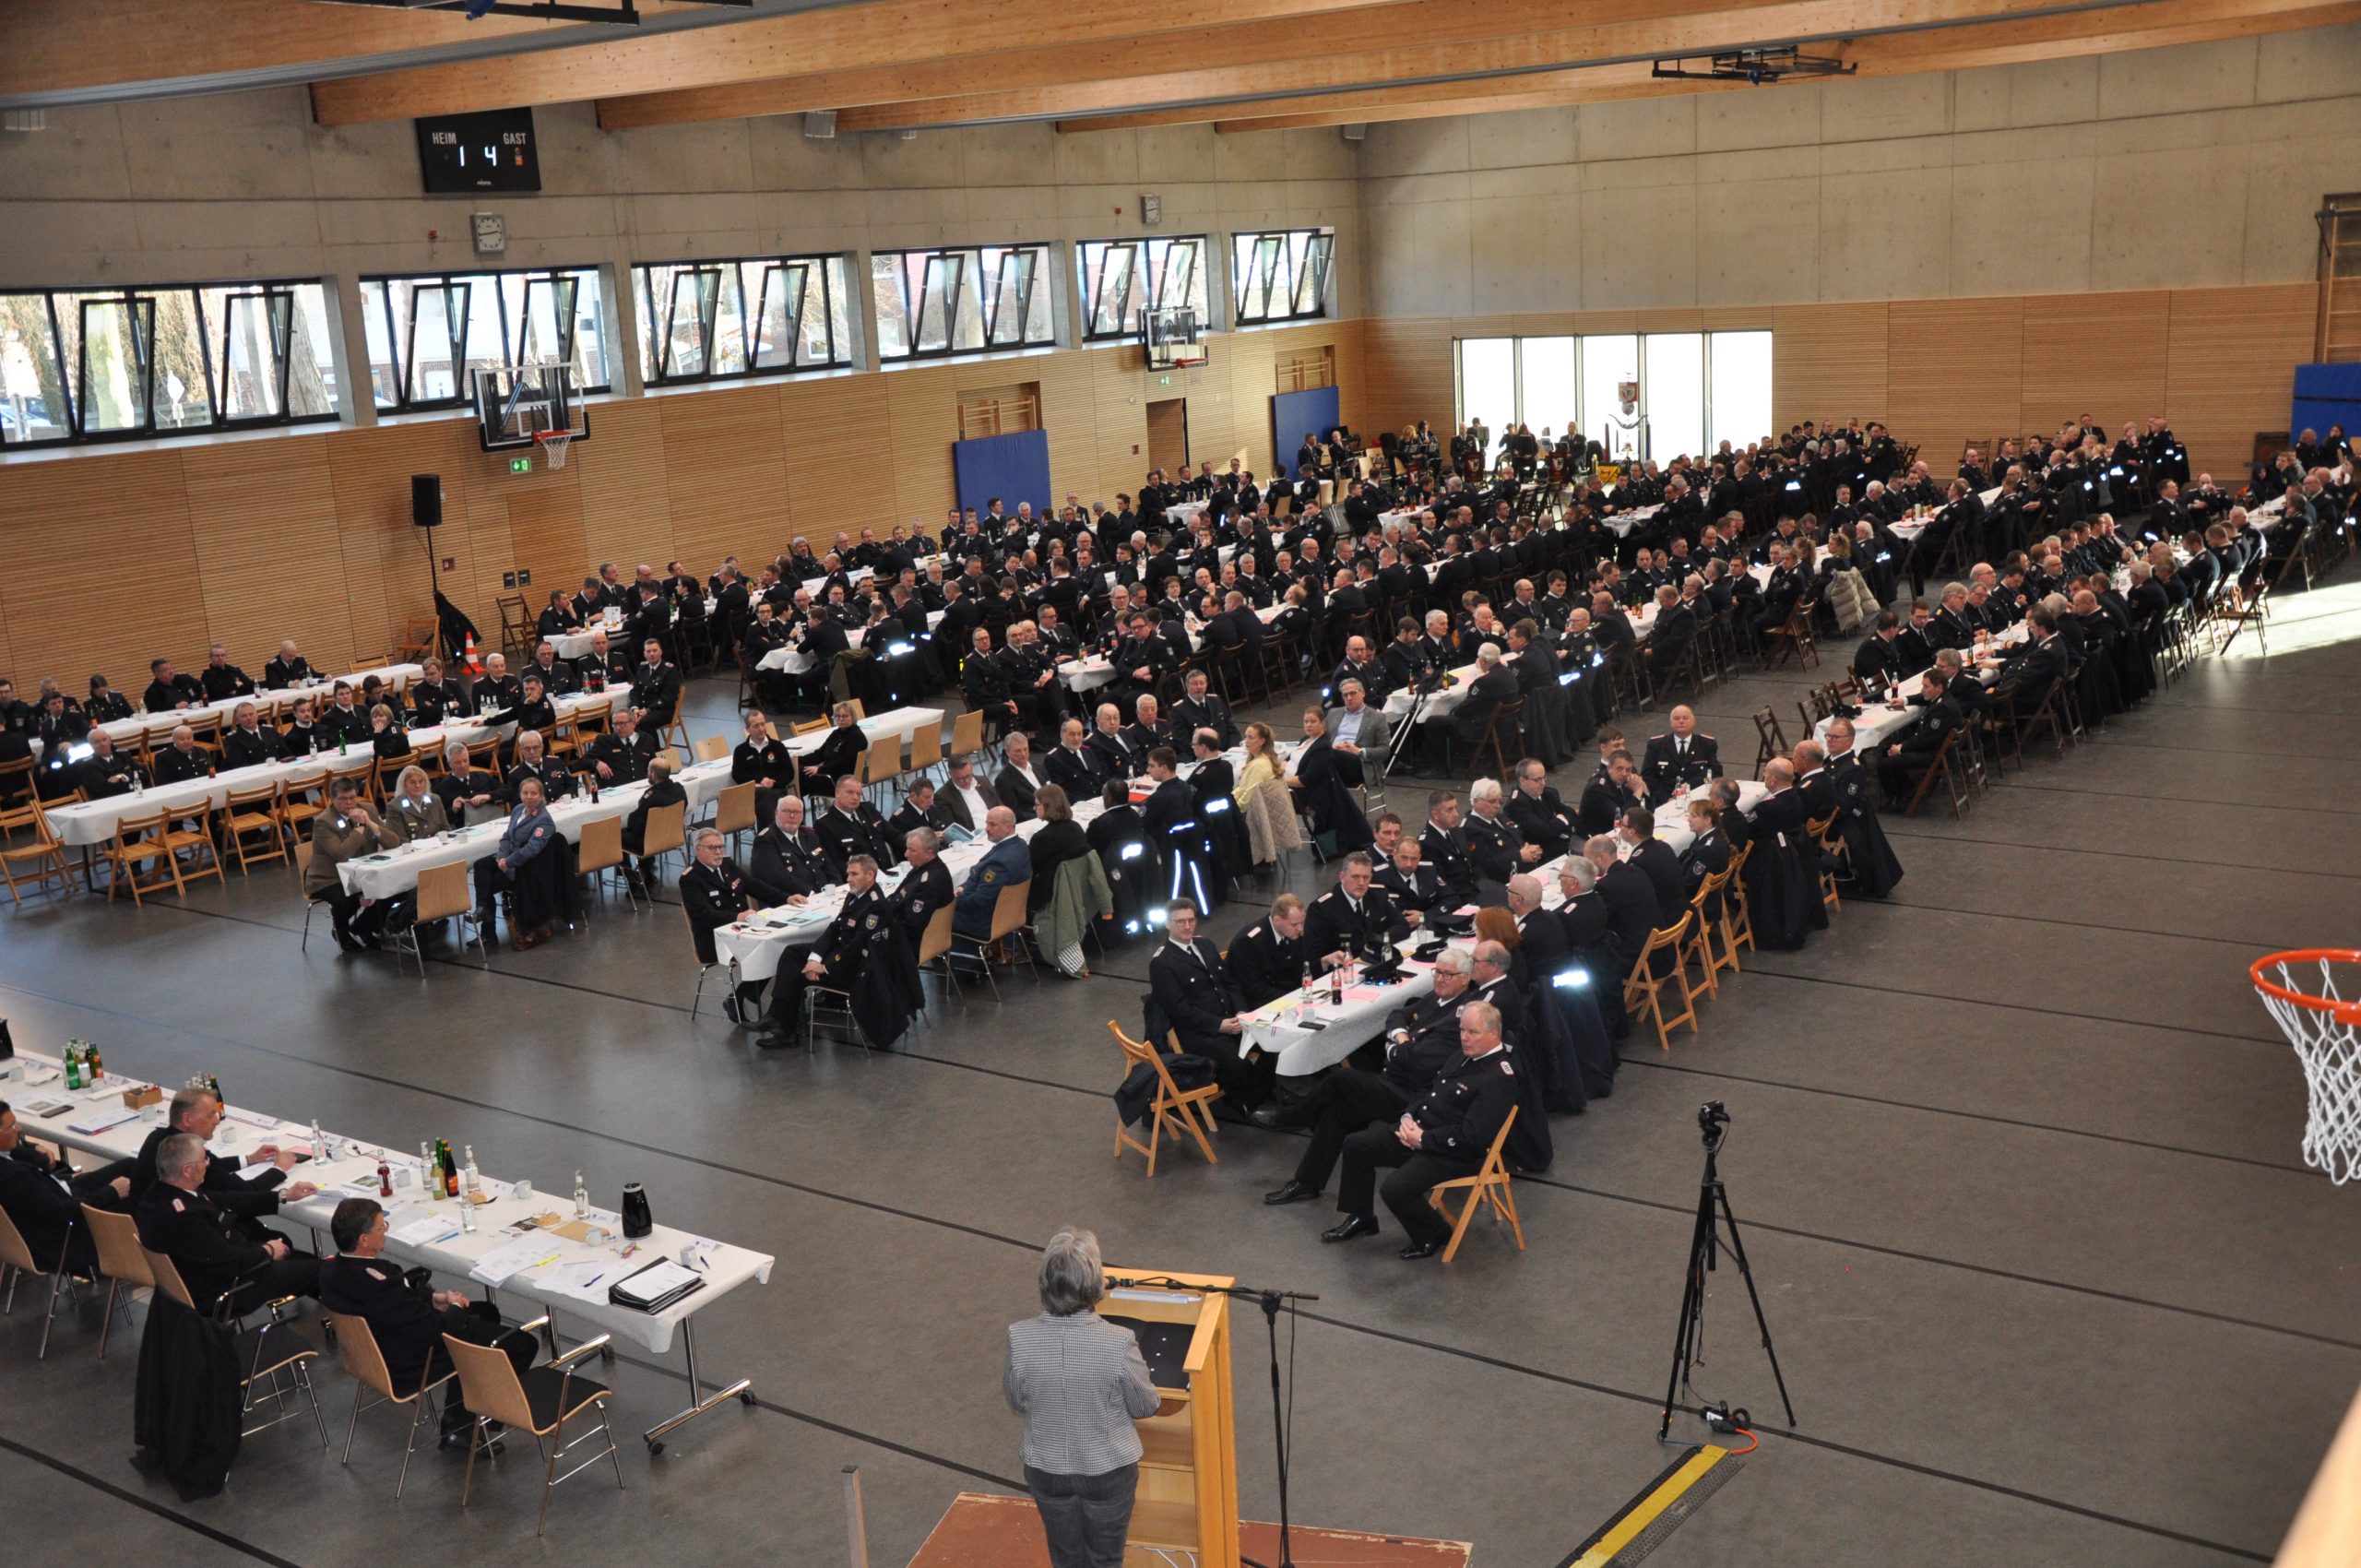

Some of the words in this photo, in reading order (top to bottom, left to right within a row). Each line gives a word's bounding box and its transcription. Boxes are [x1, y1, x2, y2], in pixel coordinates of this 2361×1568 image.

[432, 132, 457, 145] HEIM
[503, 133, 527, 145] GAST
[458, 145, 466, 167] 1
[483, 145, 497, 167] 4
